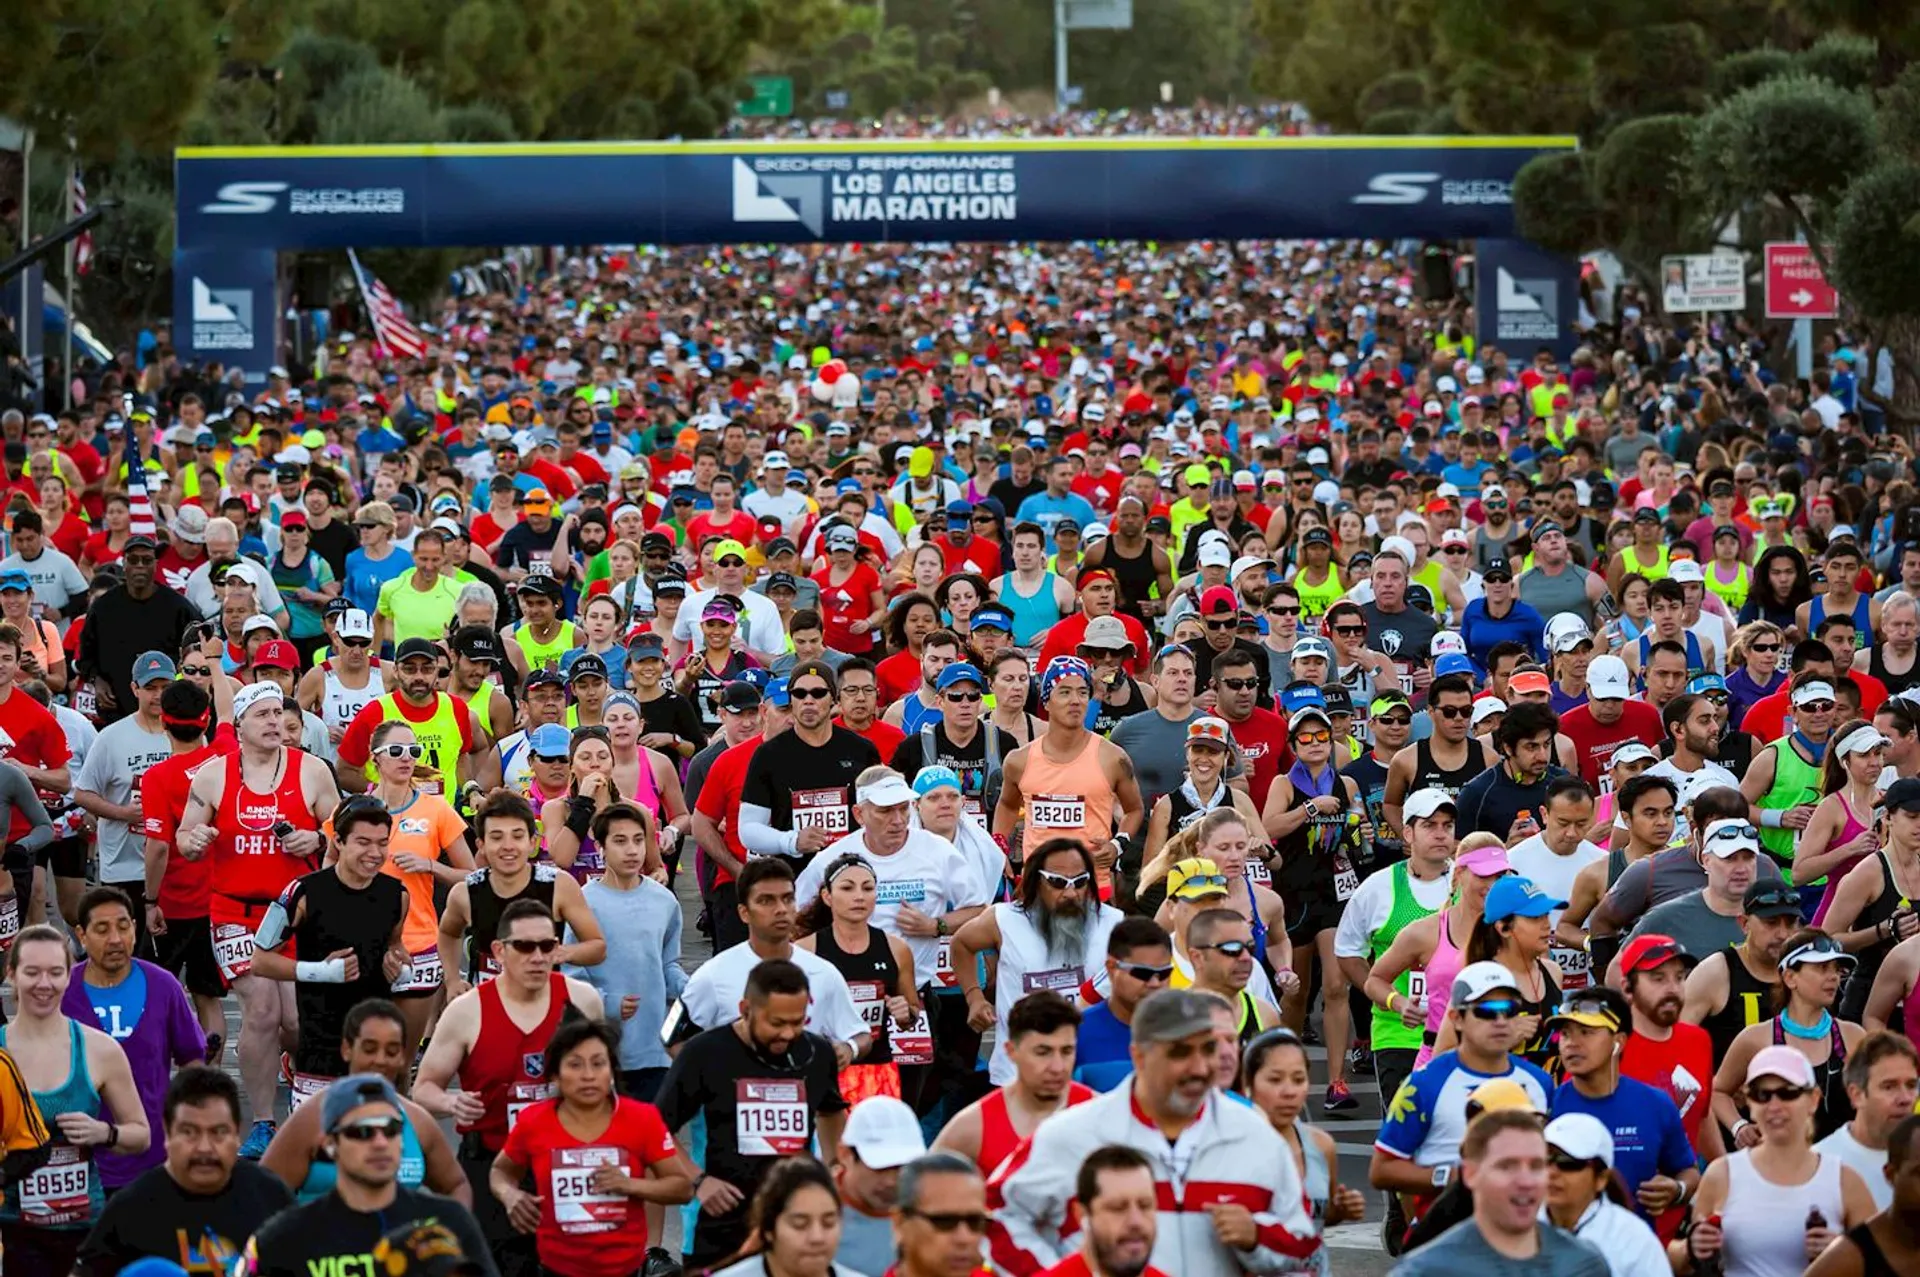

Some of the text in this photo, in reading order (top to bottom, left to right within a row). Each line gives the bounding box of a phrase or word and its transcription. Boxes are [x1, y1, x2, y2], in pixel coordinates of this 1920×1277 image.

[755, 155, 1015, 171] SKECHERS PERFORMANCE
[832, 173, 1016, 194] LOS ANGELES
[1442, 180, 1514, 192] SKECH
[290, 189, 404, 201] SKECHERS
[832, 196, 1016, 221] MARATHON
[577, 661, 599, 671] SRLA
[338, 704, 362, 719] US
[147, 752, 170, 763] RUN
[795, 810, 847, 829] 17863
[1034, 806, 1083, 823] 25206
[890, 883, 925, 891] ANGELES
[740, 1108, 804, 1132] 11958
[22, 1169, 86, 1197] E8559
[307, 1252, 376, 1277] VICT
